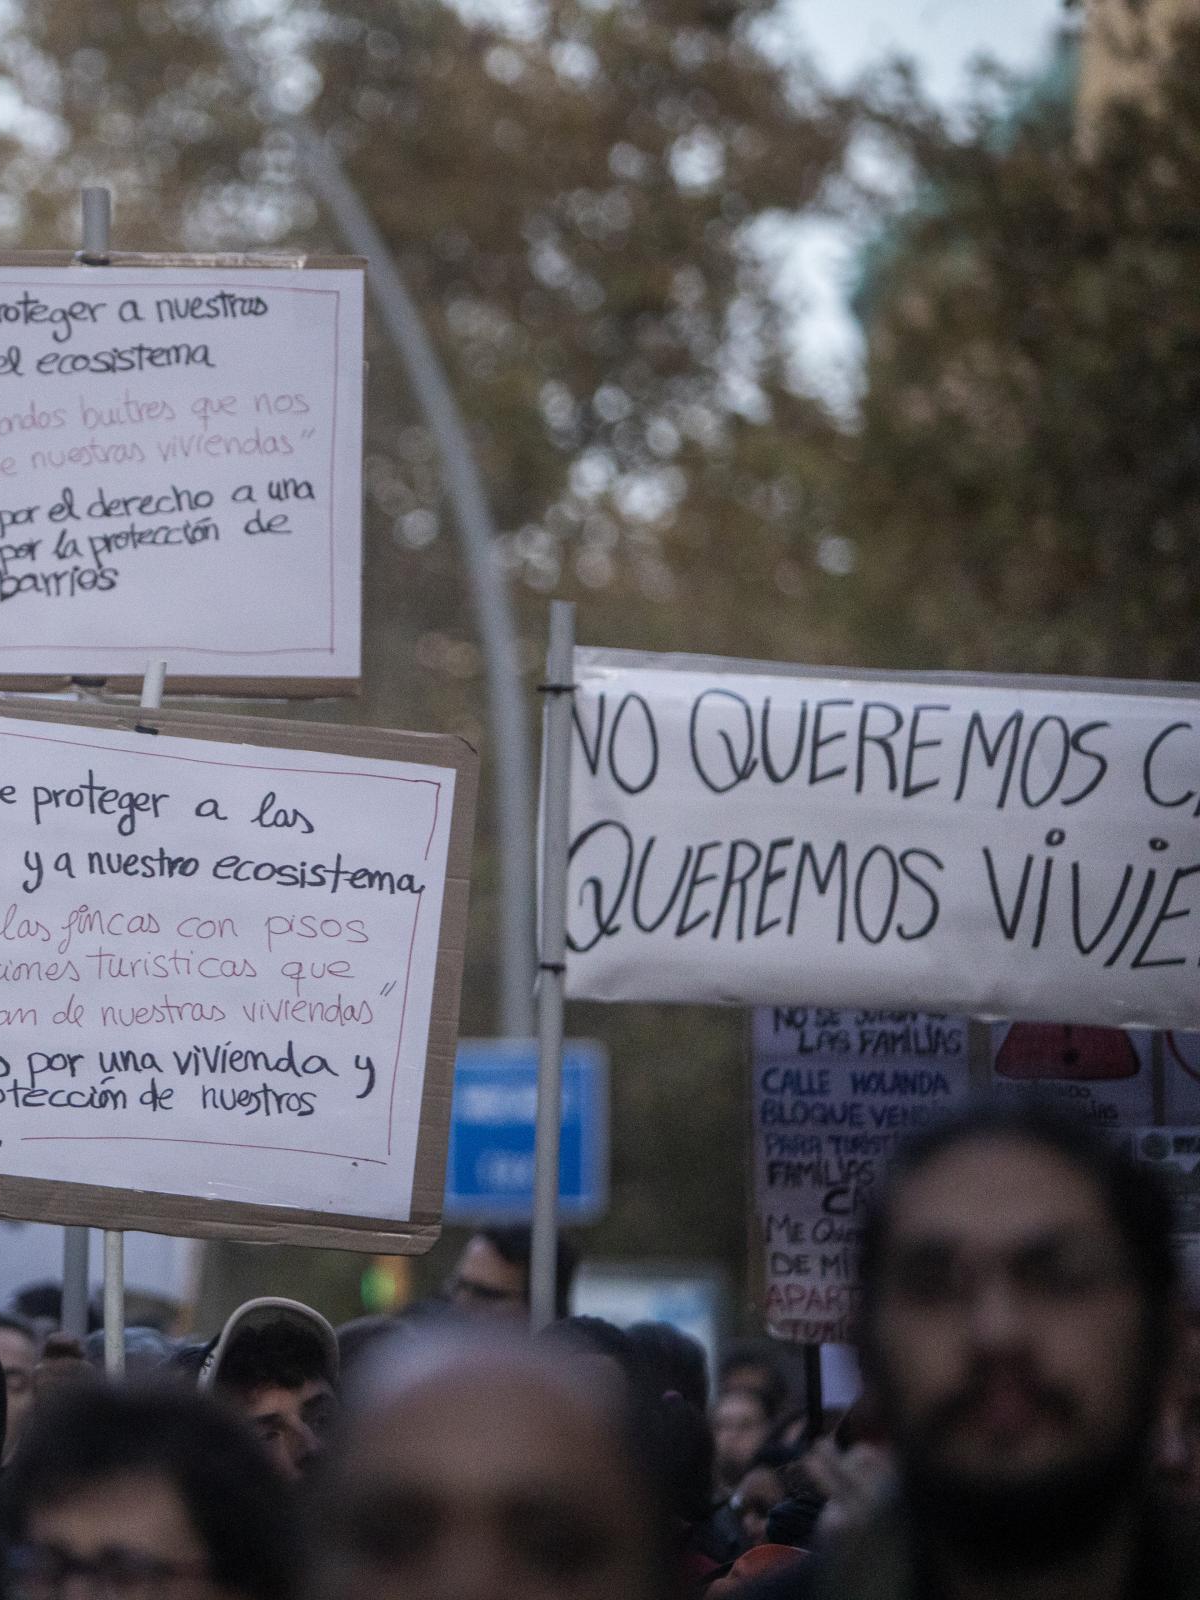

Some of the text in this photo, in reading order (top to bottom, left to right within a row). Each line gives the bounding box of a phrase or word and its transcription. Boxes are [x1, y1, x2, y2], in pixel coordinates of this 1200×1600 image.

[118, 300, 144, 322] a
[156, 290, 269, 321] nuestras
[36, 341, 216, 375] ecosistema
[82, 397, 177, 429] buitres
[190, 395, 237, 431] que
[255, 391, 311, 414] nos
[32, 438, 145, 469] nuestras
[48, 487, 79, 522] el
[86, 485, 214, 520] derecho
[231, 483, 255, 503] a
[267, 477, 316, 501] una
[54, 530, 81, 559] la
[88, 519, 221, 571] protección
[244, 509, 291, 536] de
[0, 564, 119, 602] barrios
[688, 686, 1111, 809] QUEREMOS
[1142, 721, 1200, 817] C
[32, 768, 170, 835] proteger
[194, 797, 229, 822] a
[250, 790, 315, 834] las
[23, 846, 50, 893] y
[53, 850, 78, 877] a
[87, 841, 200, 877] nuestro
[564, 818, 1200, 969] QUEREMOS VIVIE
[57, 902, 161, 954] fincas
[176, 914, 240, 939] con
[265, 912, 371, 953] pisos
[280, 957, 355, 997] que
[52, 993, 85, 1028] de
[100, 999, 227, 1028] nuestras
[28, 1050, 86, 1092] por
[98, 1045, 162, 1078] una
[173, 1039, 340, 1079] vivienda
[352, 1058, 377, 1099] y
[761, 1067, 831, 1096] CALLE
[138, 1083, 175, 1111] de
[200, 1085, 316, 1118] nuestros
[760, 1100, 865, 1126] BLOQUE
[771, 1252, 811, 1277] DE
